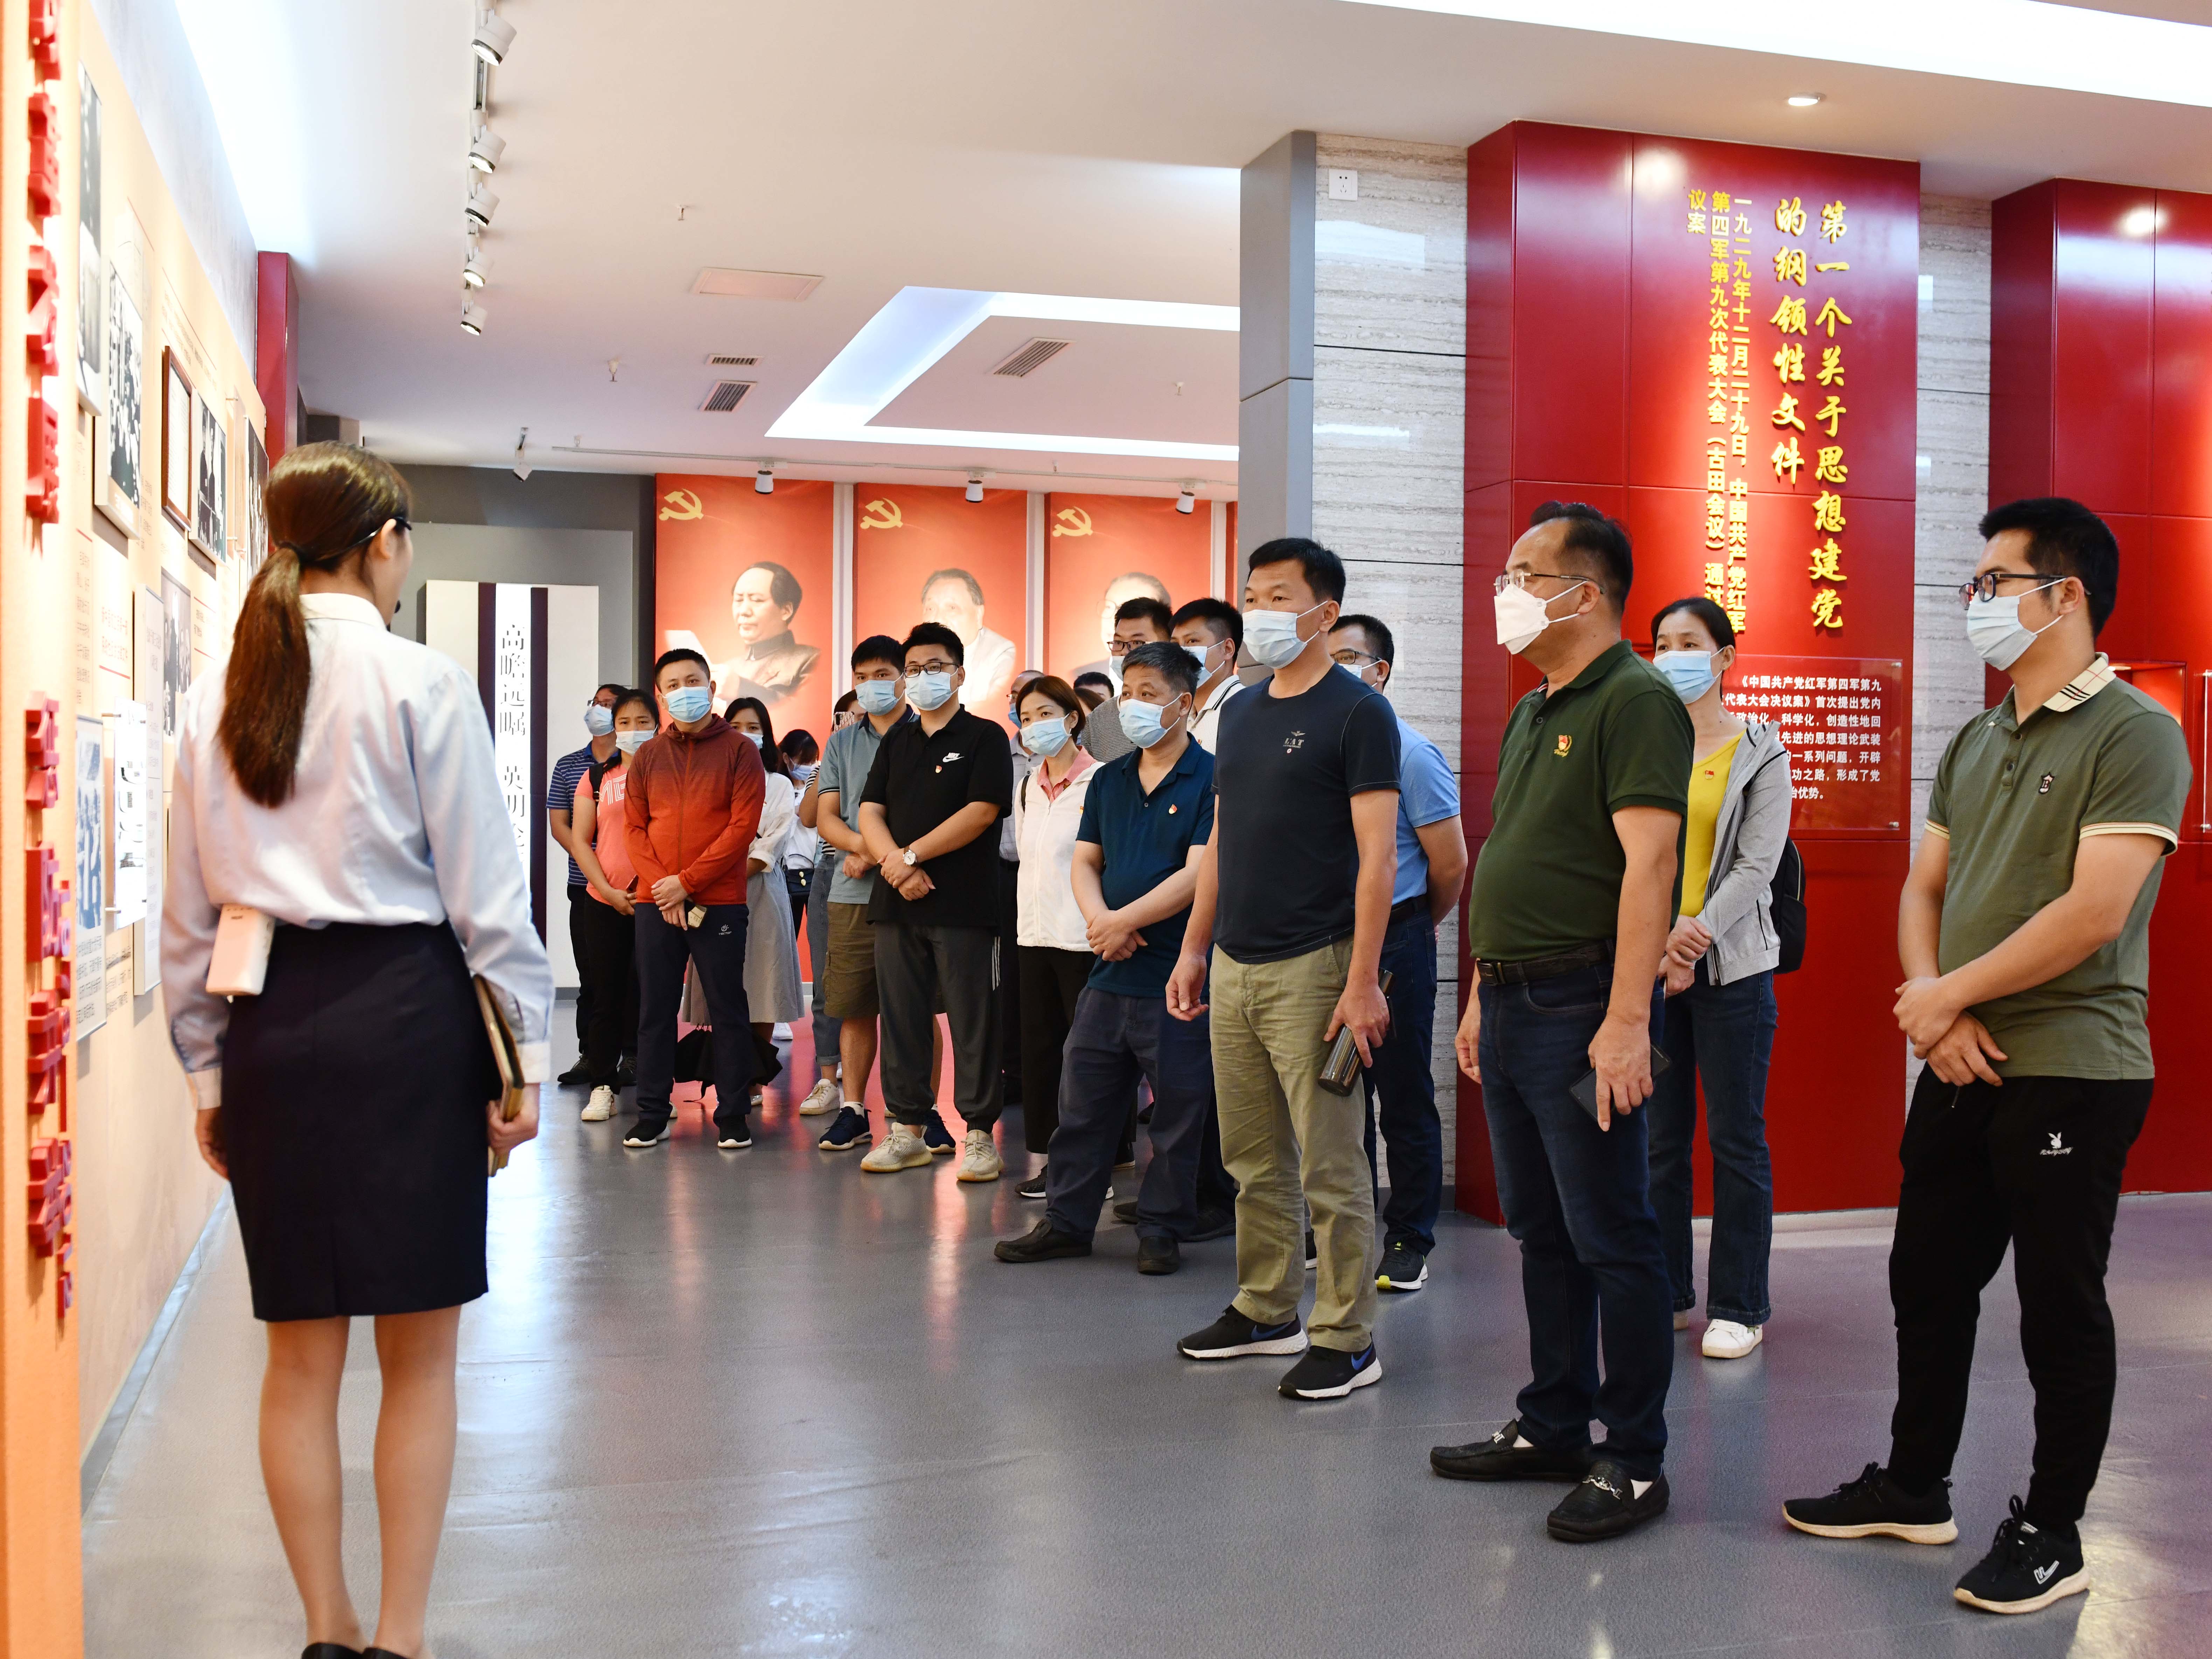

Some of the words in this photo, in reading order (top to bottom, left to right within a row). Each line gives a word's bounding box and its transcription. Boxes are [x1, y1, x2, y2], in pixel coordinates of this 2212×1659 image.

[1687, 189, 1706, 234] 议案
[1770, 197, 1807, 485] 的纲领性文件
[1808, 201, 1852, 627] 第一个关于思想建党
[1741, 675, 1881, 692] 《中国共产党红军第四军第九
[1722, 693, 1881, 710] 代表大会决议案》首次提出党内
[1790, 768, 1880, 782] 功之路，形成了党
